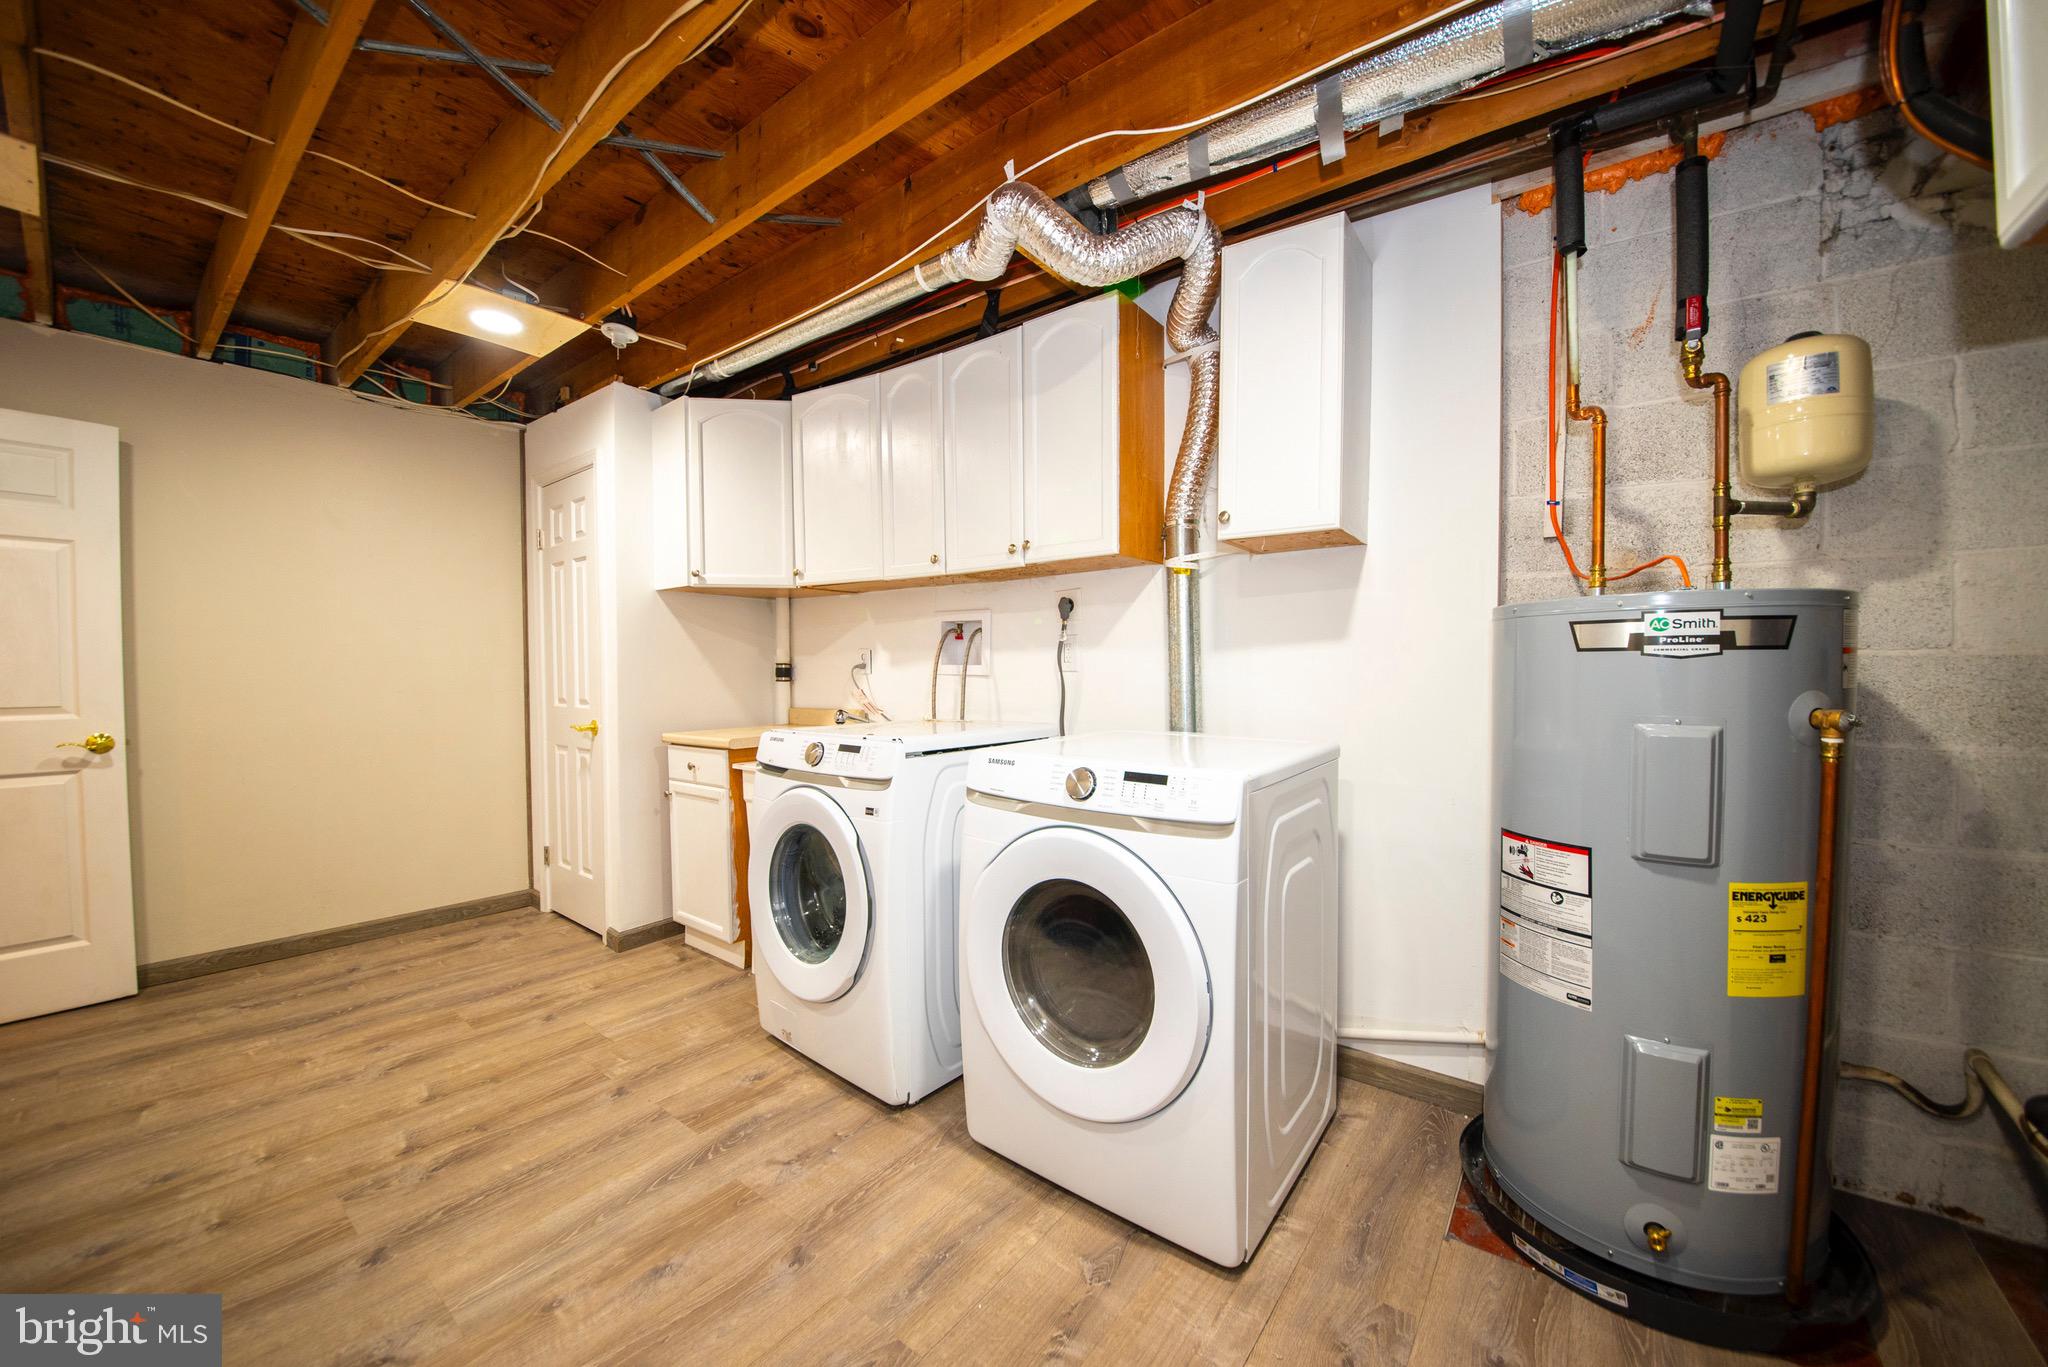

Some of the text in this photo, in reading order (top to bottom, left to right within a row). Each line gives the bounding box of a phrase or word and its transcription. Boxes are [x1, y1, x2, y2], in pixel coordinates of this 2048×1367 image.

[1672, 618, 1716, 629] Smith
[987, 757, 1016, 767] SAMSUNG
[1732, 891, 1805, 902] ENERGYGUIDE
[1745, 914, 1768, 923] 423
